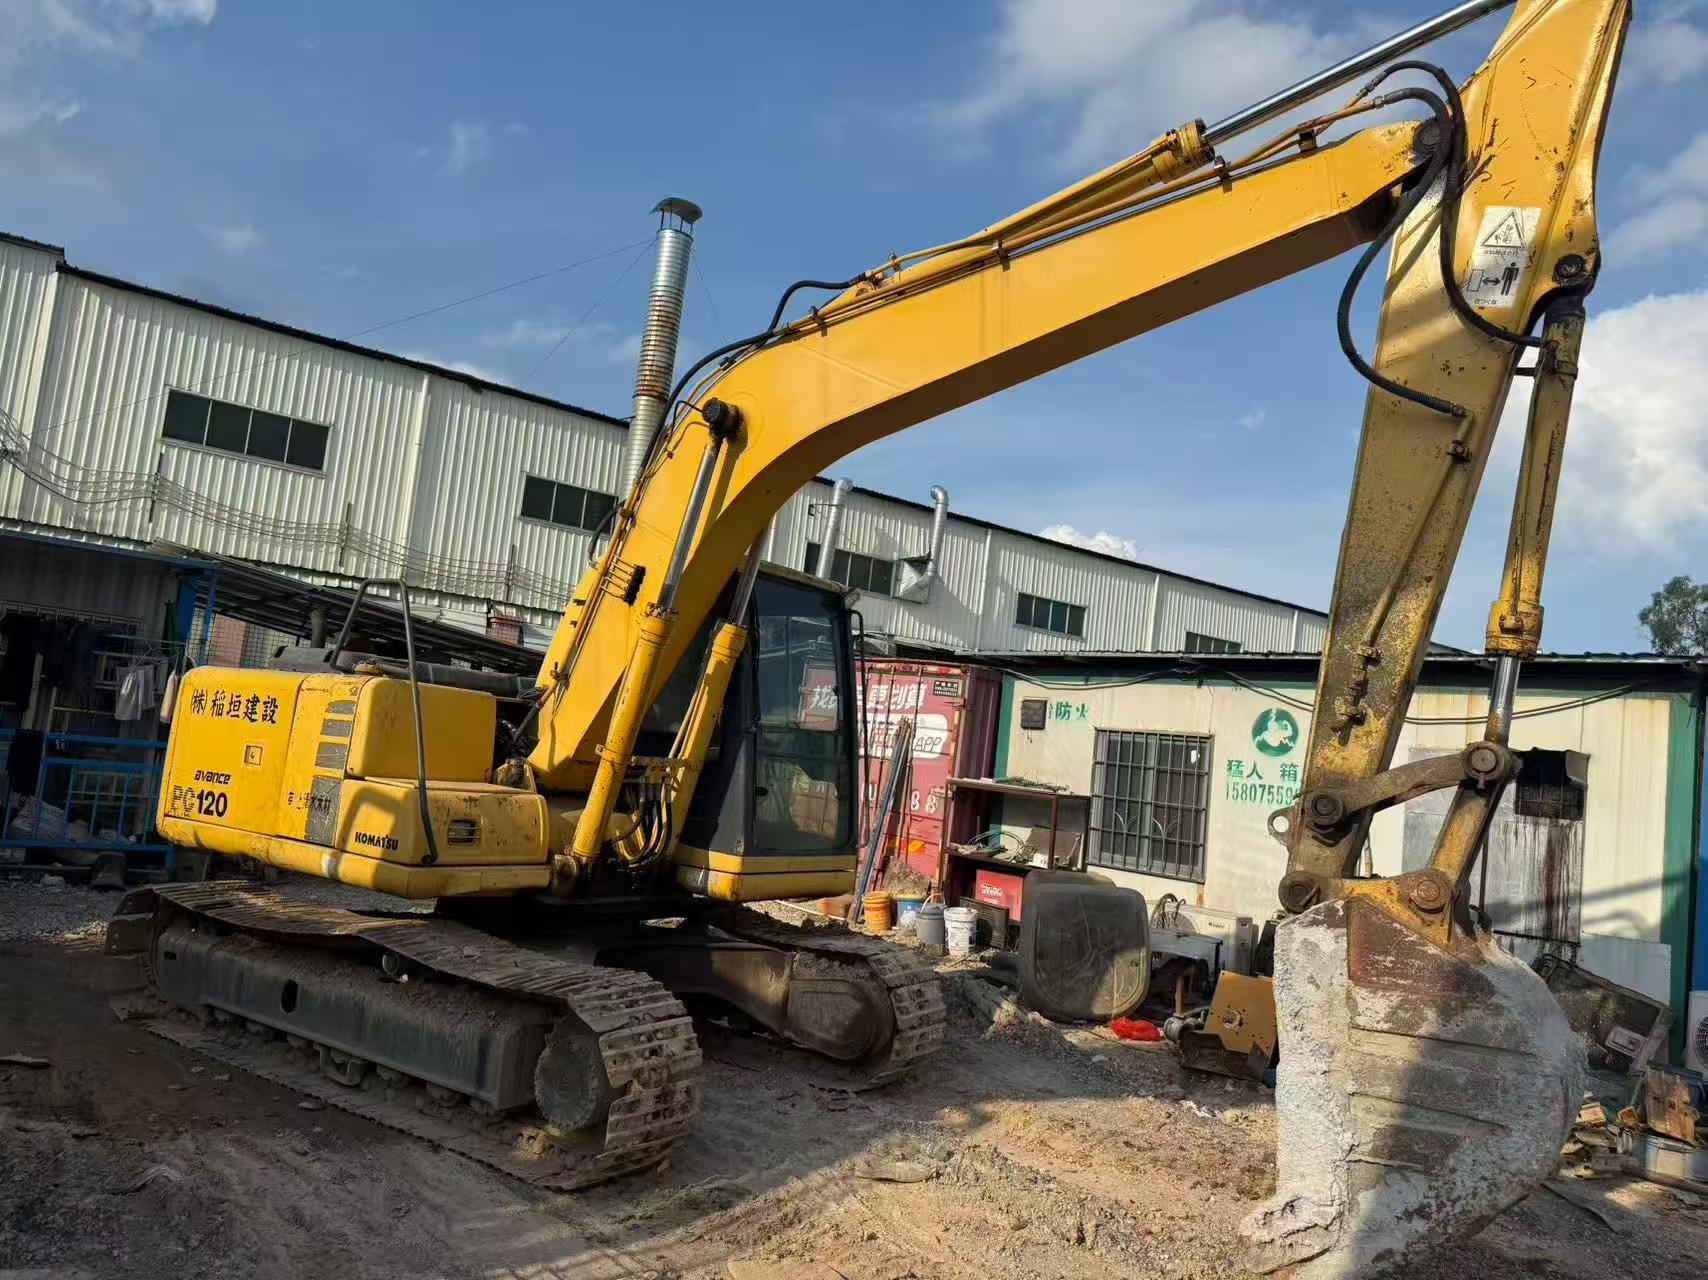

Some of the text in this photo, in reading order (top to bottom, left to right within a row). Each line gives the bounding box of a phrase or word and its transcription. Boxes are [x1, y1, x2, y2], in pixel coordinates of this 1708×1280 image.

[1048, 701, 1088, 721] 防火
[914, 736, 943, 752] APP
[194, 769, 231, 786] avance
[1226, 781, 1300, 806] 15807559
[354, 831, 399, 851] KOMATSU
